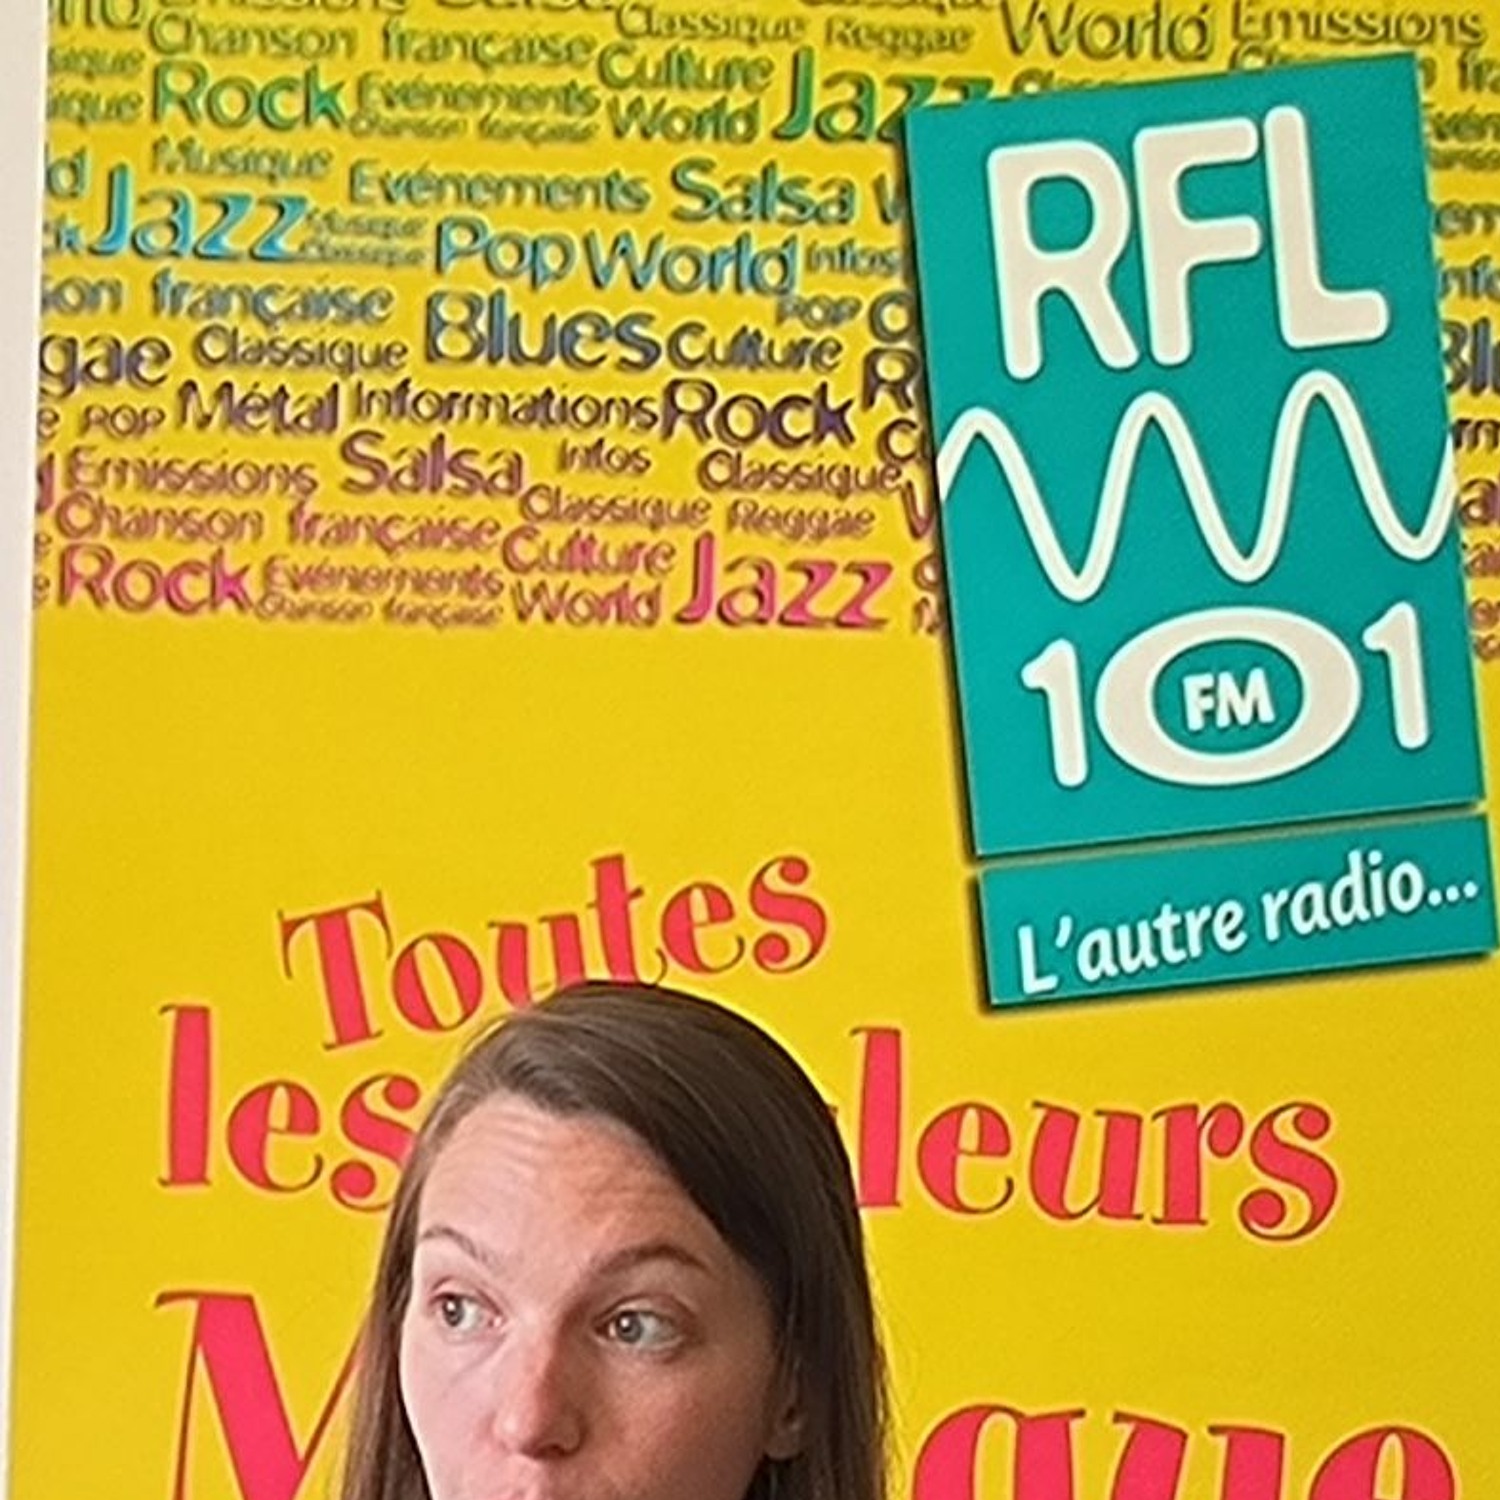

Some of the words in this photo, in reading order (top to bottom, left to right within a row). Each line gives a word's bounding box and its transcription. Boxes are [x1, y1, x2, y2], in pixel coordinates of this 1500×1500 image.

[149, 11, 356, 58] Chanson
[616, 2, 807, 49] Classique
[823, 16, 973, 58] Reggae
[1002, 0, 1214, 63] World
[1231, 2, 1487, 46] Emissions
[152, 60, 347, 131] Rock
[597, 38, 775, 92] Culture
[606, 93, 762, 145] World
[88, 160, 312, 262] Jazz
[349, 158, 652, 215] Evénements
[670, 155, 857, 226] Salsa
[434, 213, 578, 294] Pop
[579, 226, 800, 299] World
[986, 105, 1391, 382] RFL
[149, 264, 397, 330] française
[424, 286, 664, 375] Blues
[193, 322, 410, 380] Classique
[666, 318, 845, 374] Culture
[175, 378, 341, 435] Métal
[350, 375, 659, 432] Informations
[661, 378, 856, 448] Rock
[64, 443, 319, 498] Emissions
[338, 428, 523, 497] Salsa
[556, 436, 652, 477] Infos
[697, 448, 904, 501] Classique
[54, 490, 265, 545] Chanson
[518, 484, 714, 533] Classique
[58, 543, 253, 616] Rock
[502, 524, 678, 578] Culture
[673, 530, 897, 632] Jazz
[511, 577, 665, 628] World
[1021, 601, 1430, 789] 101
[1183, 667, 1277, 733] FM
[277, 853, 828, 1052] Toutes
[1017, 901, 1248, 995] L'autre
[158, 1003, 422, 1212] les
[852, 1026, 1340, 1243] leurs
